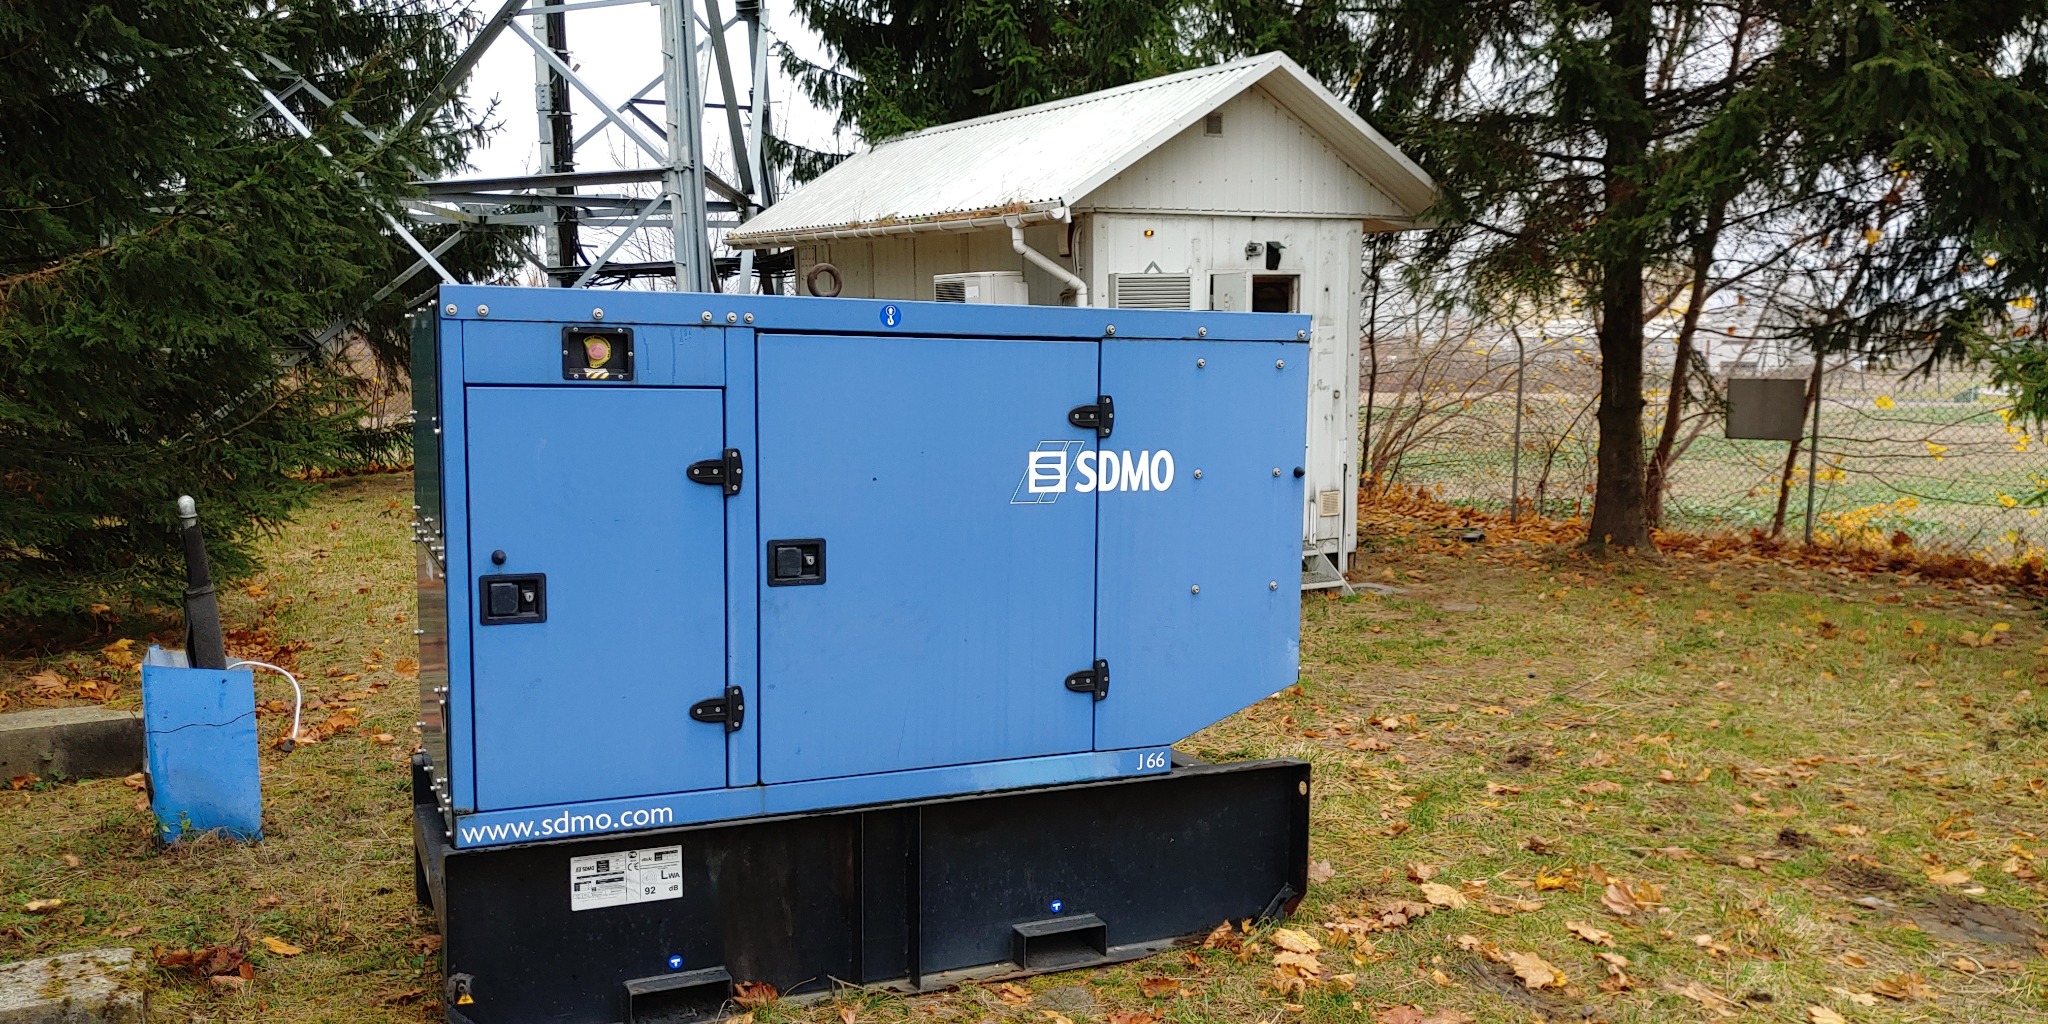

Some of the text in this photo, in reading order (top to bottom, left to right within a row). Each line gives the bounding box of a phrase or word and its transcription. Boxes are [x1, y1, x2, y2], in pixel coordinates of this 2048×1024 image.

[1074, 449, 1175, 493] SDMO
[1136, 751, 1165, 771] J 66
[461, 806, 673, 844] www.sdmo.com
[644, 884, 679, 895] 92 dB
